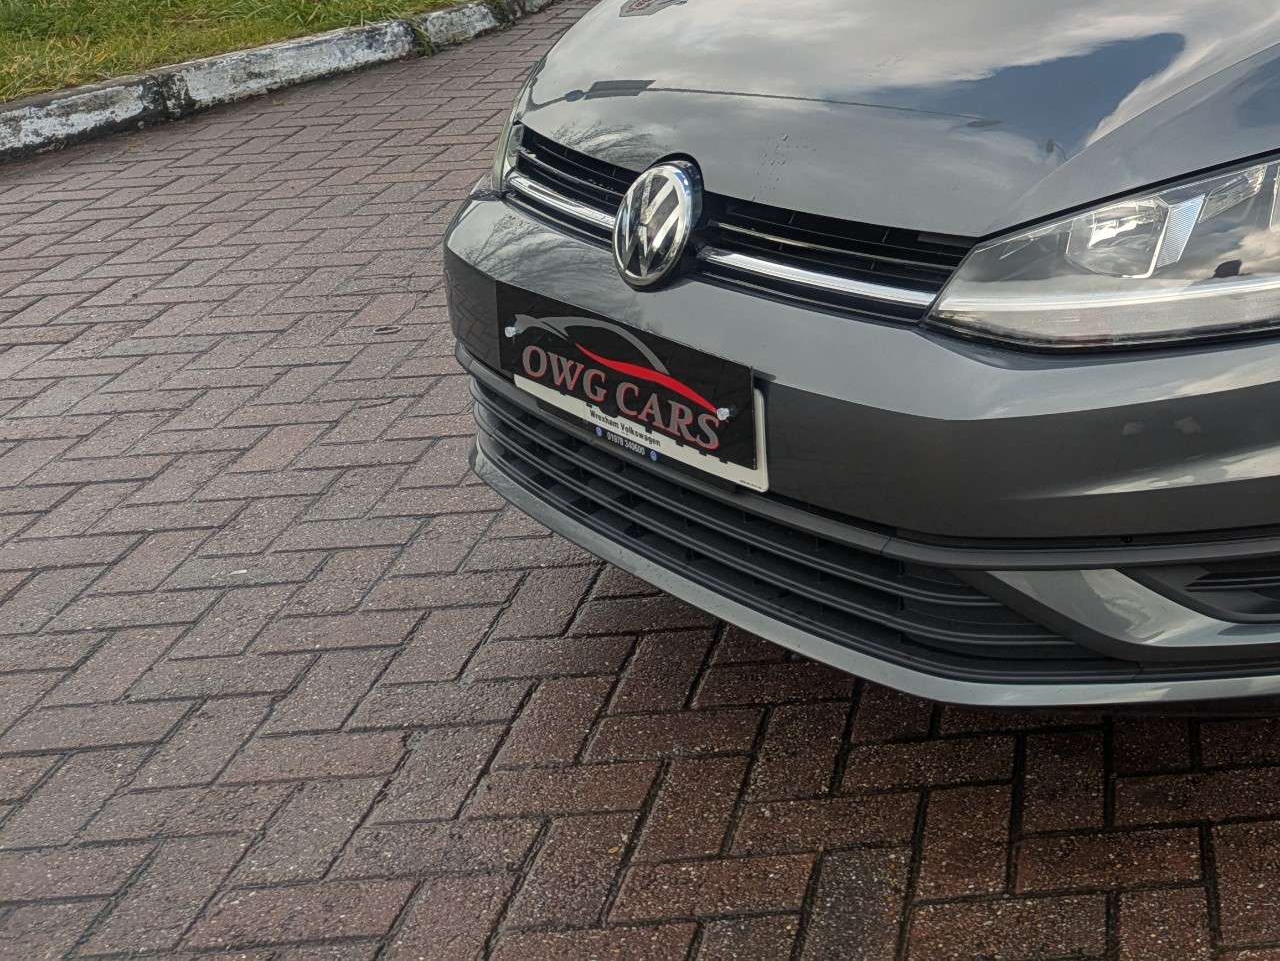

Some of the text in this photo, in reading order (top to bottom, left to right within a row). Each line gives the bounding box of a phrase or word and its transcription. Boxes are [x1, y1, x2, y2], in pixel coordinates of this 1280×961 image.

[522, 345, 721, 452] OWG CARS
[589, 409, 662, 447] Wrexham Volkswagen
